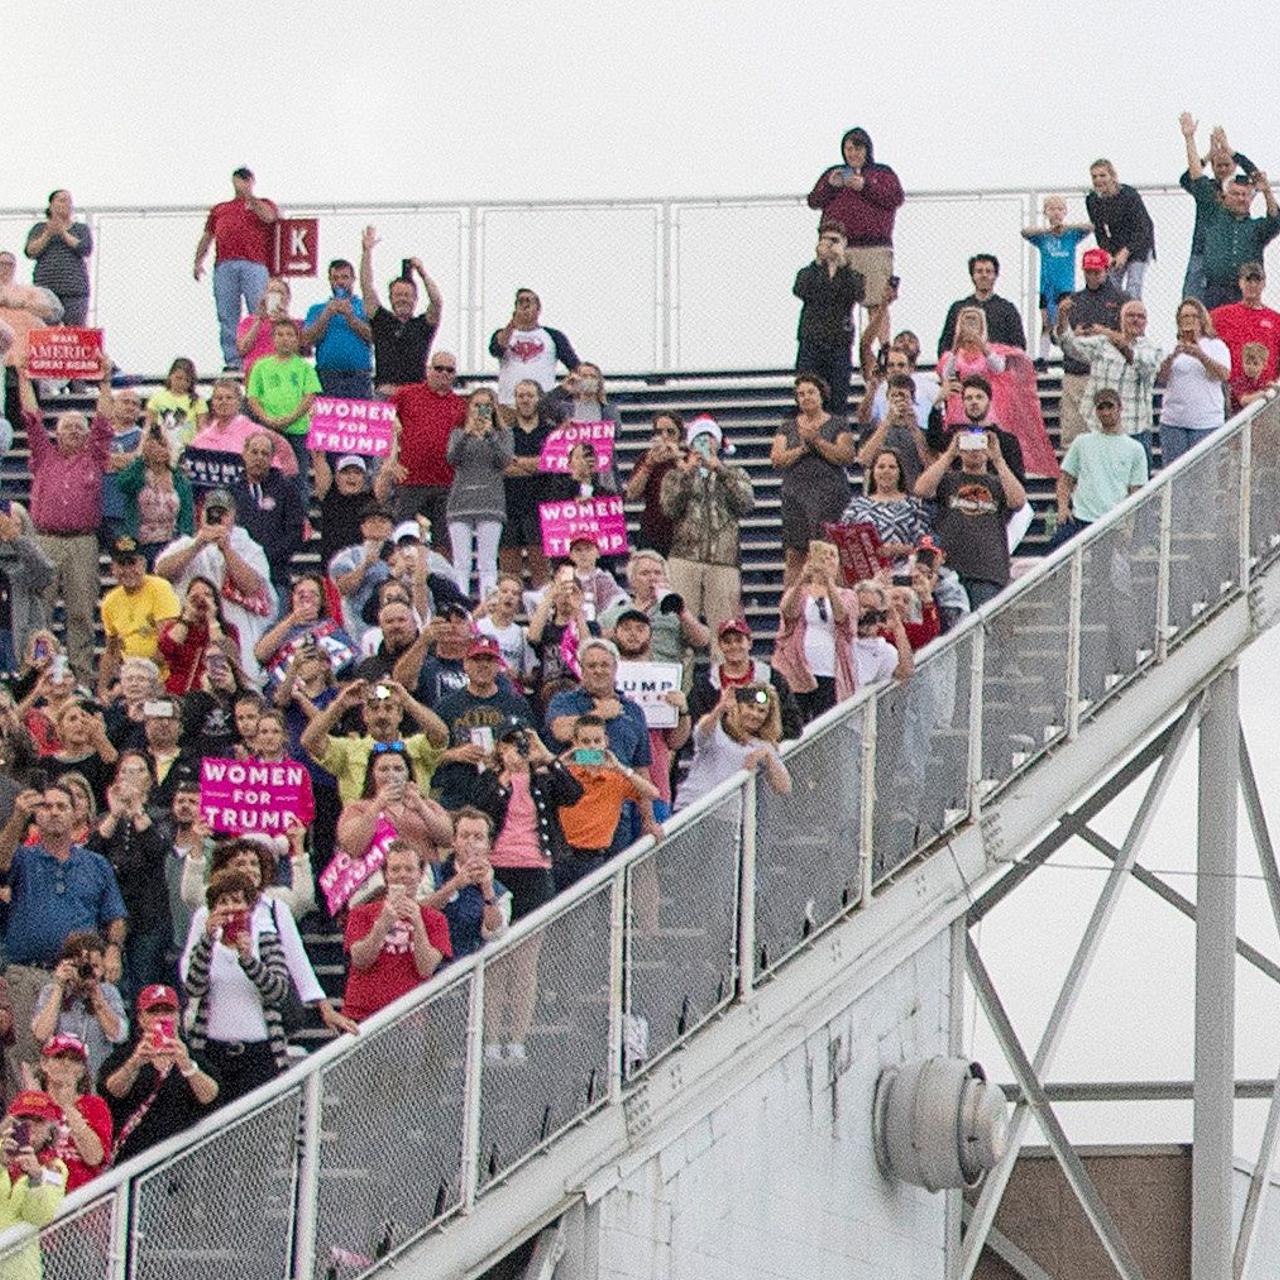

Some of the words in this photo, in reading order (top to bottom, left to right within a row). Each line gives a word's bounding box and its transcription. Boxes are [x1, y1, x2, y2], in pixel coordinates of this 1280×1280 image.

[291, 229, 309, 256] K
[315, 401, 396, 420] WOMEN
[338, 422, 368, 433] FOR
[315, 433, 388, 451] TRUMP
[545, 456, 610, 471] TRP
[542, 501, 623, 520] WOMEN
[204, 763, 303, 787] WOMEN
[232, 790, 272, 805] FOR
